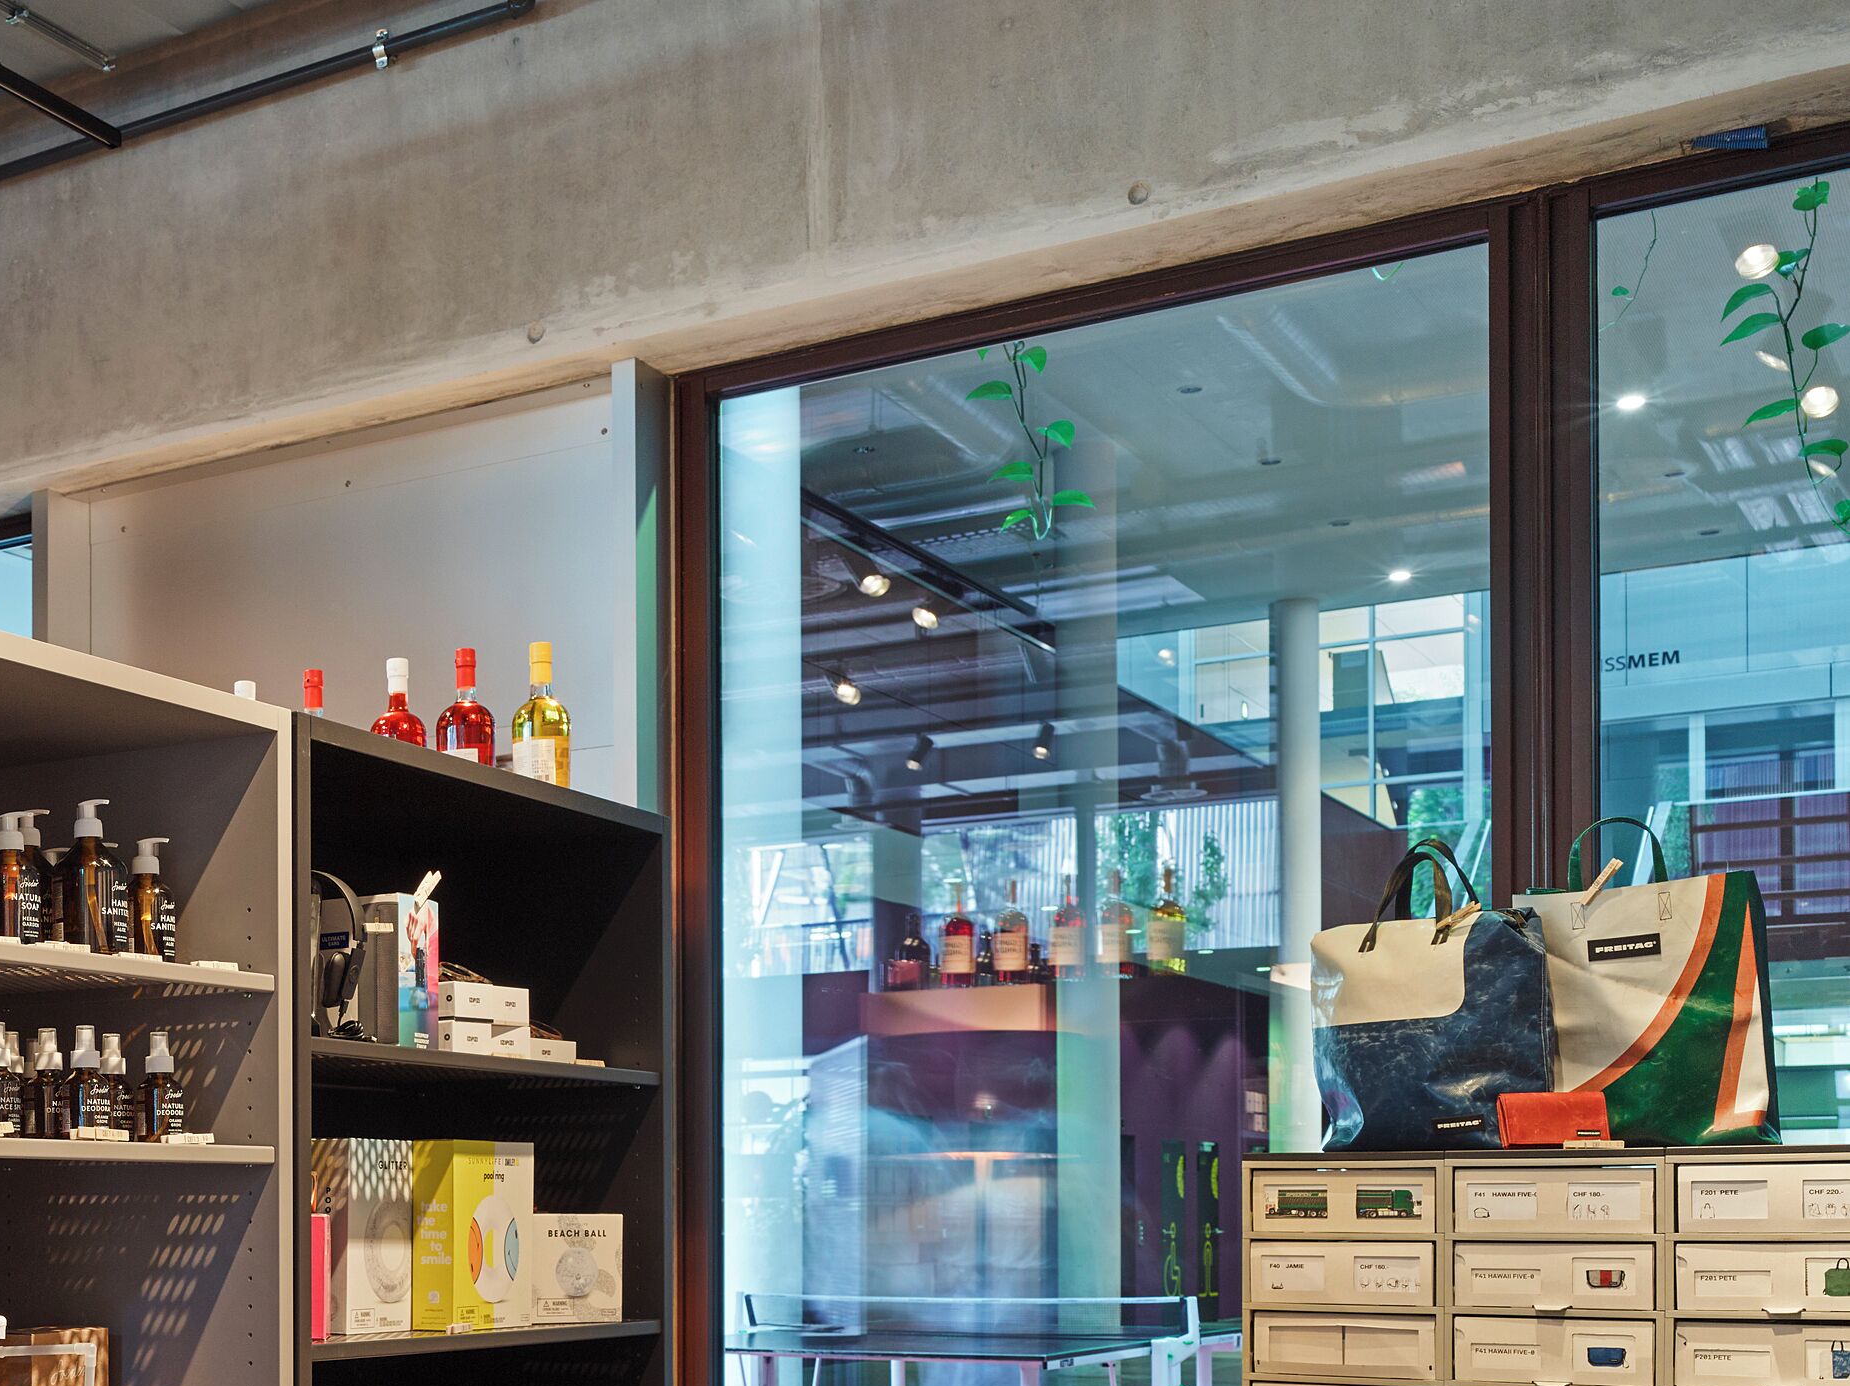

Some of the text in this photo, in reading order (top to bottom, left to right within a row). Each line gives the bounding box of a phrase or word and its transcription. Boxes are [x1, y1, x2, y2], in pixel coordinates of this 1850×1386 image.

[1595, 941, 1657, 954] FREITAG
[1437, 1119, 1482, 1128] FREITAG
[378, 1160, 407, 1170] GLITTER
[421, 1202, 448, 1212] take
[418, 1215, 434, 1226] the
[420, 1229, 447, 1239] time
[548, 1230, 607, 1238] BEACH BALL
[430, 1240, 442, 1251] to
[421, 1253, 452, 1265] smile
